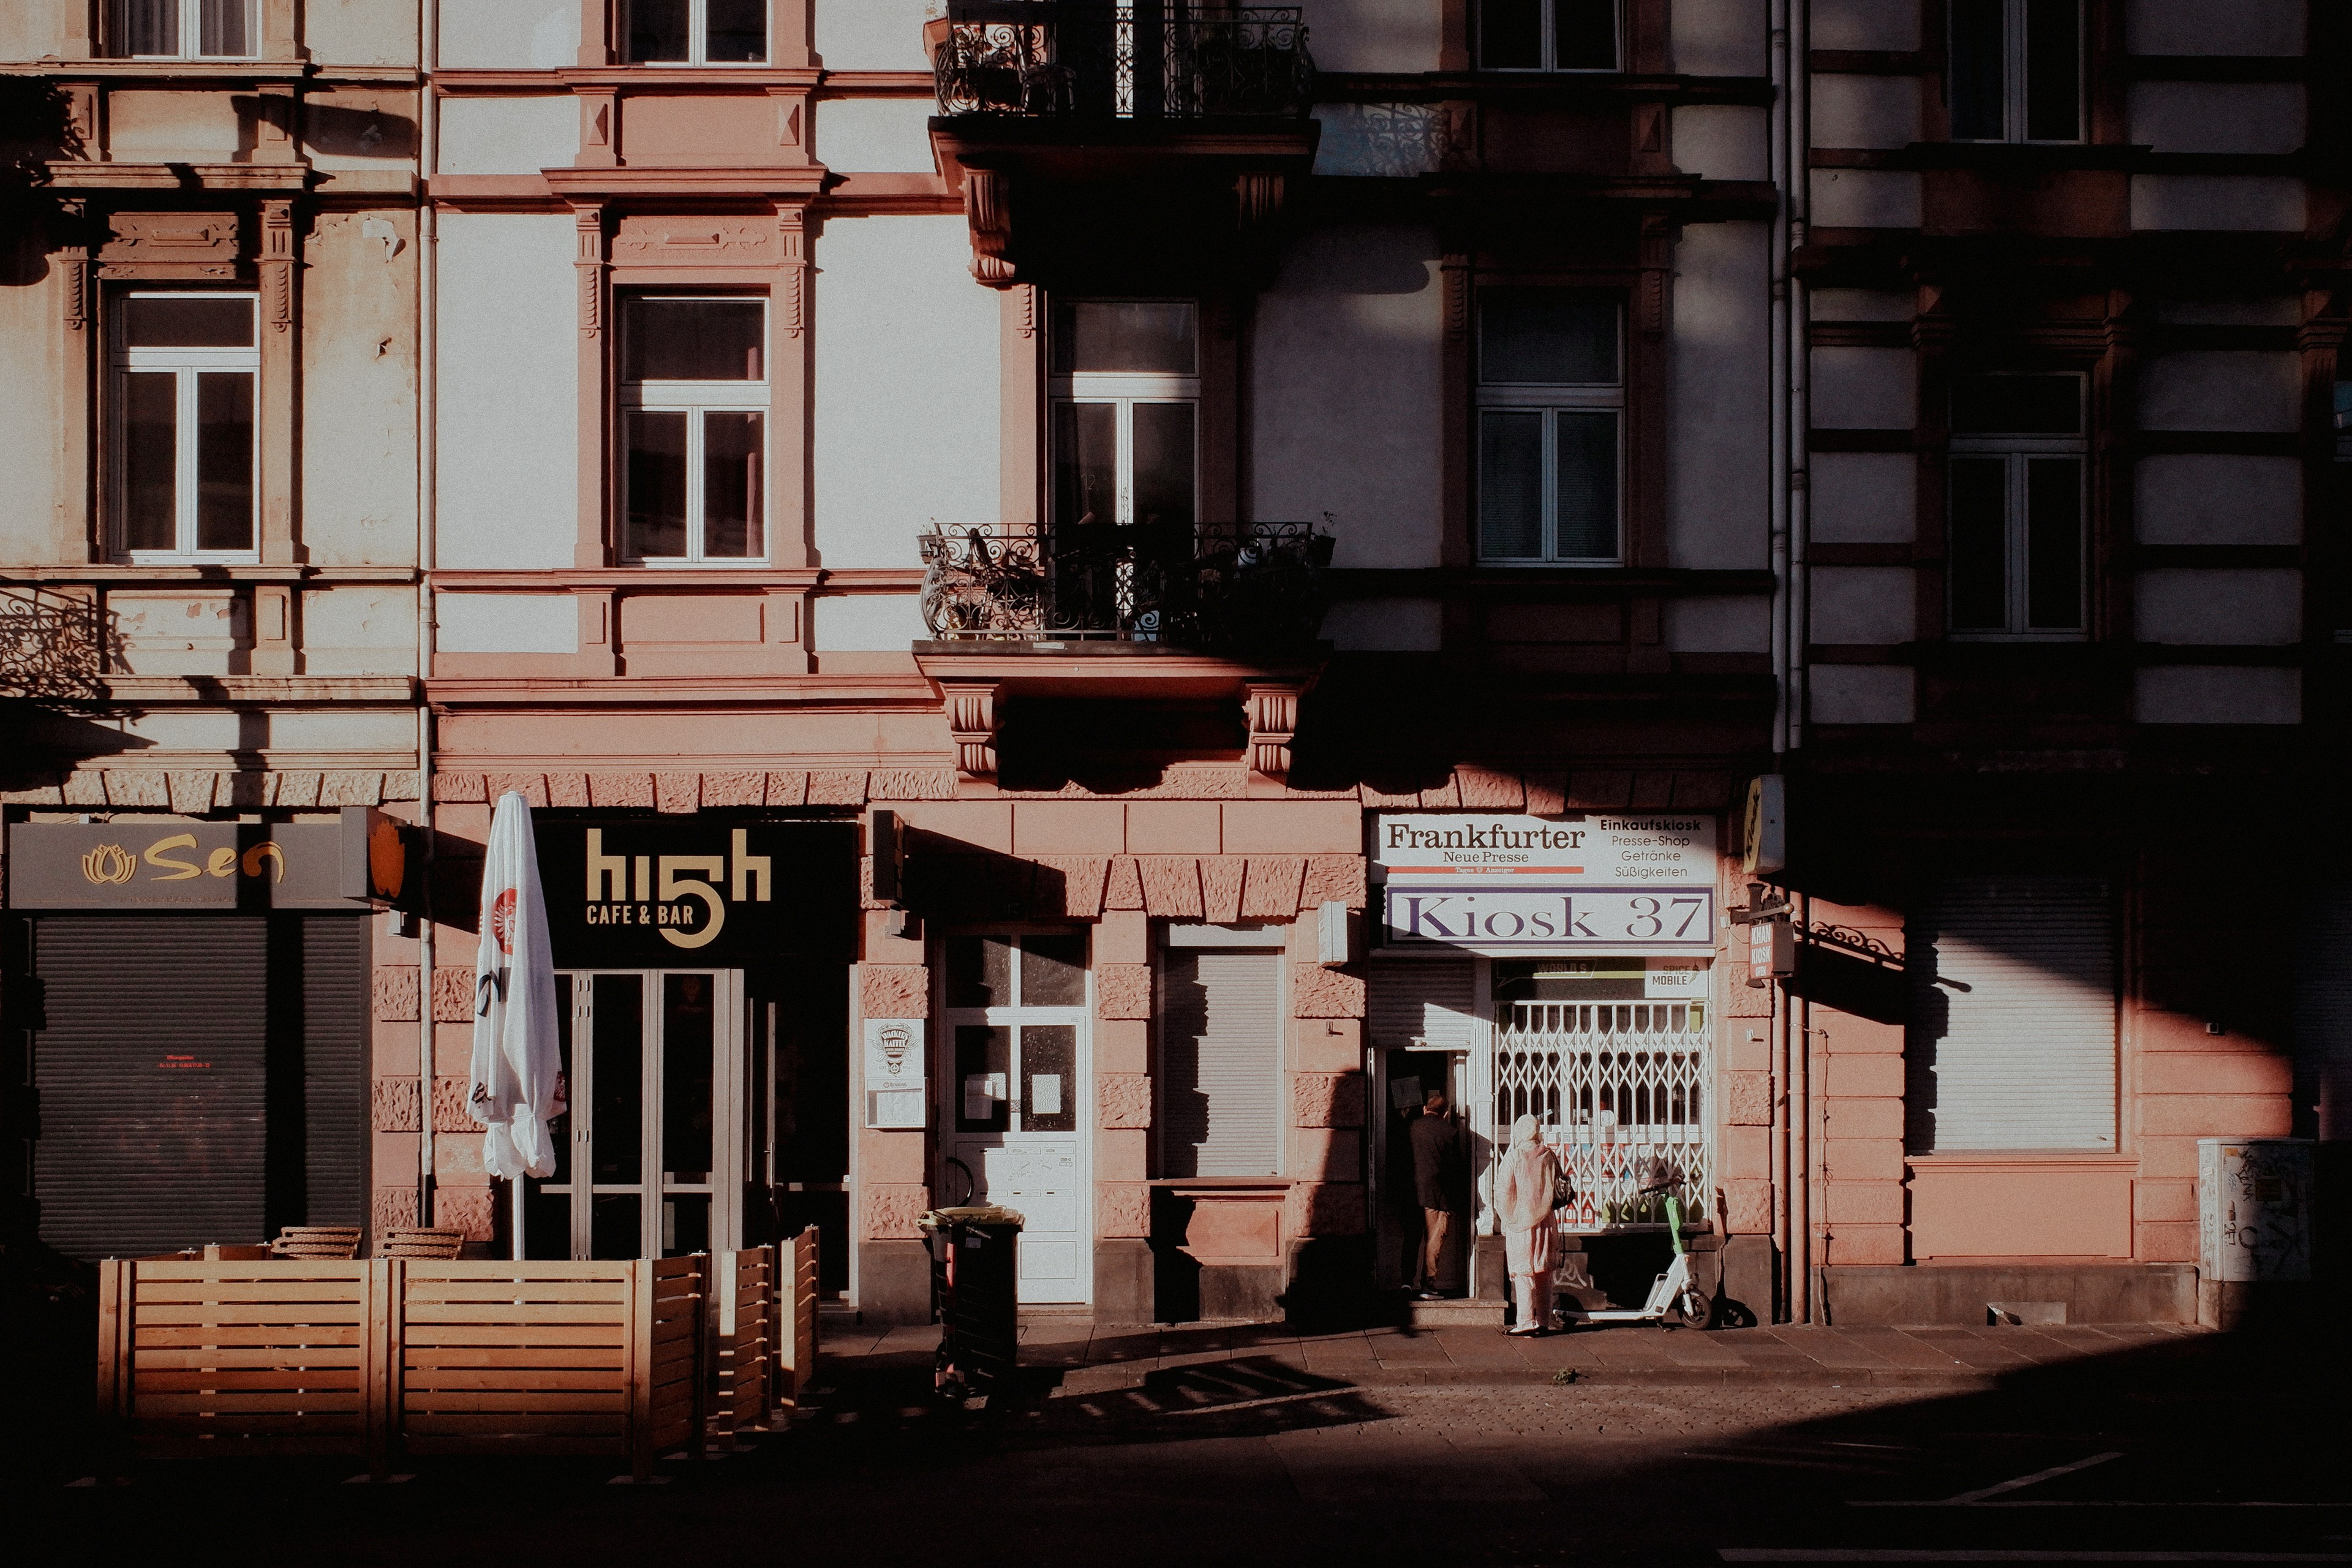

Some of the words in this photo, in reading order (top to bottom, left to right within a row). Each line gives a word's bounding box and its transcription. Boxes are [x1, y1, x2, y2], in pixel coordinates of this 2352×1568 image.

[1600, 819, 1701, 831] Einkaufskiosk
[1387, 823, 1585, 850] Frankfurter
[1612, 835, 1690, 848] Presse-Shop
[145, 833, 285, 883] Sen
[1443, 851, 1480, 862] Neue
[1482, 851, 1529, 862] Presse
[1621, 850, 1681, 861] Getränke
[1615, 866, 1687, 879] Süßigkeiten
[586, 905, 632, 924] CAFE
[639, 905, 650, 924] &
[658, 905, 693, 924] BAR
[1400, 896, 1602, 938] Kiosk
[1626, 896, 1703, 938] 37
[1751, 924, 1771, 946] KHAN
[1751, 945, 1771, 965] KIOSK
[1663, 965, 1690, 975] SPICE
[1653, 976, 1687, 985] MOBILE
